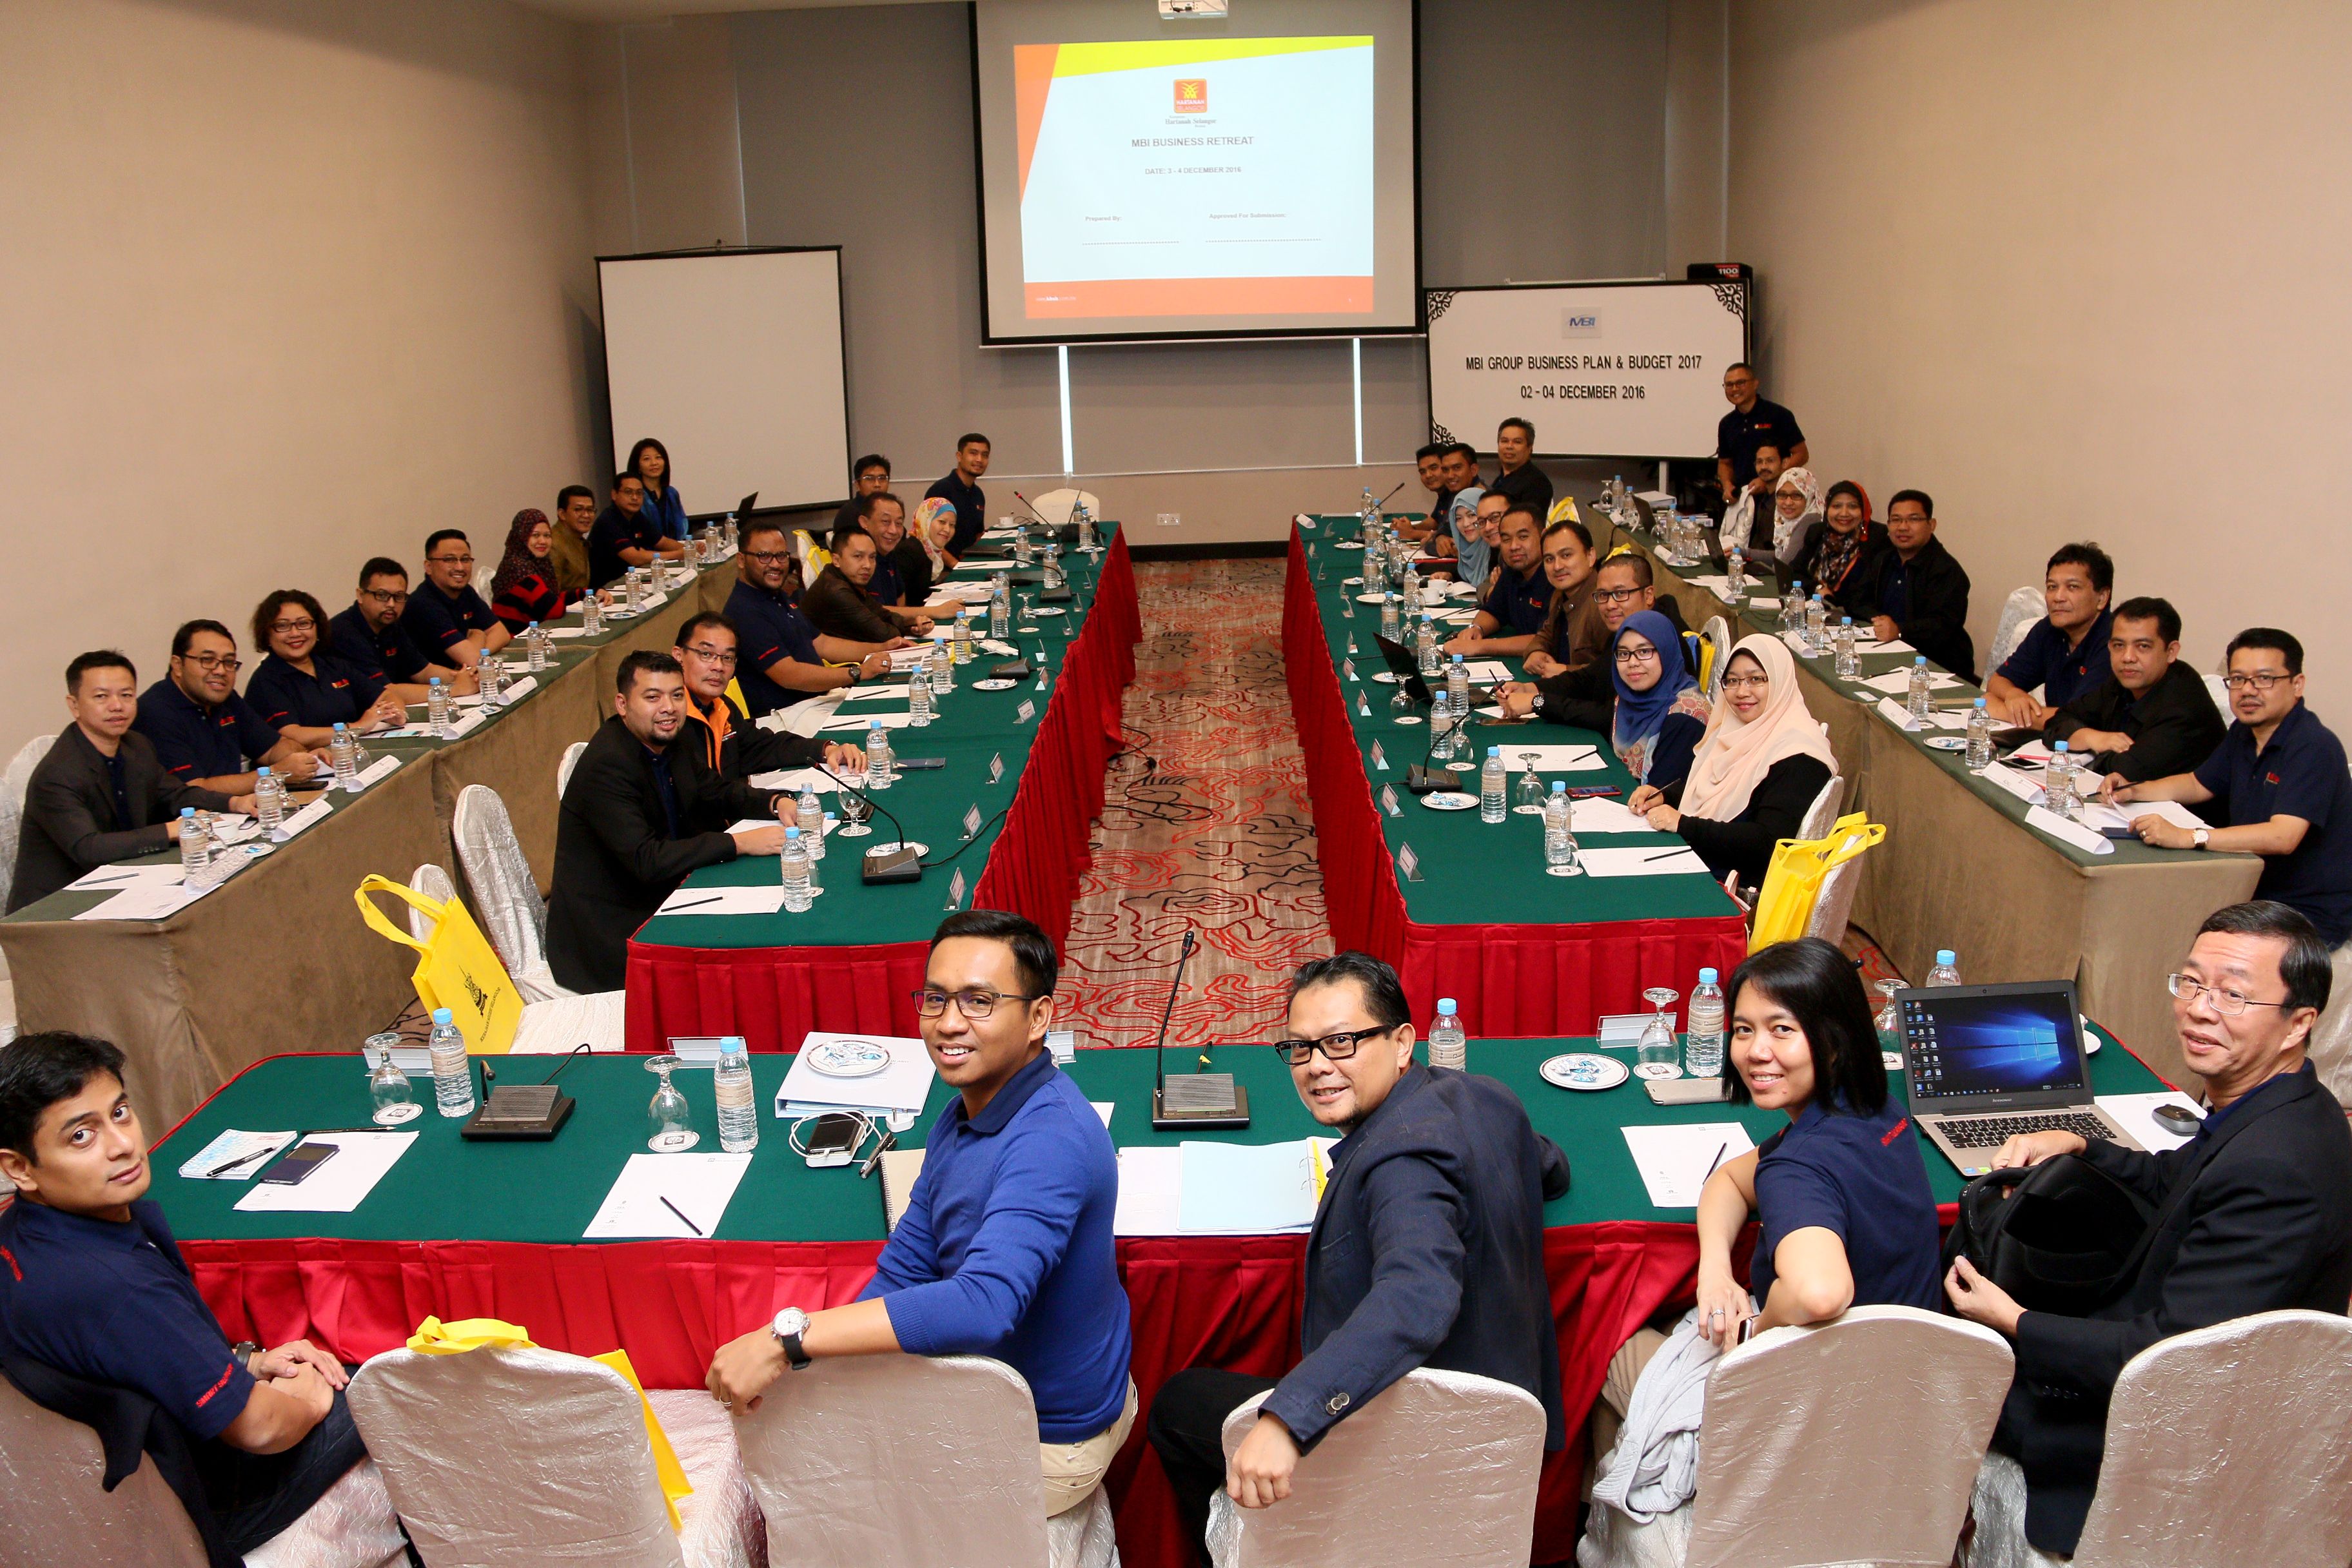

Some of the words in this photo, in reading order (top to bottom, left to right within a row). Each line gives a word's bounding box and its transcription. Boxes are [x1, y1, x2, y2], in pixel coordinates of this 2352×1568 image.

[1153, 137, 1204, 146] BUSINESS
[1206, 136, 1254, 145] RETREAT
[1569, 317, 1596, 327] MBI
[1466, 357, 1484, 370] MBI
[1488, 357, 1524, 370] GROUP
[1528, 356, 1578, 369] BUSINESS
[1583, 355, 1611, 369] PLAN
[1616, 355, 1623, 369] &
[1629, 355, 1672, 369] BUDGET
[1678, 355, 1702, 369] 2017
[1520, 386, 1533, 399] 02
[1543, 386, 1555, 399] 04
[1560, 385, 1617, 399] DECEMBER
[1622, 386, 1645, 399] 2016
